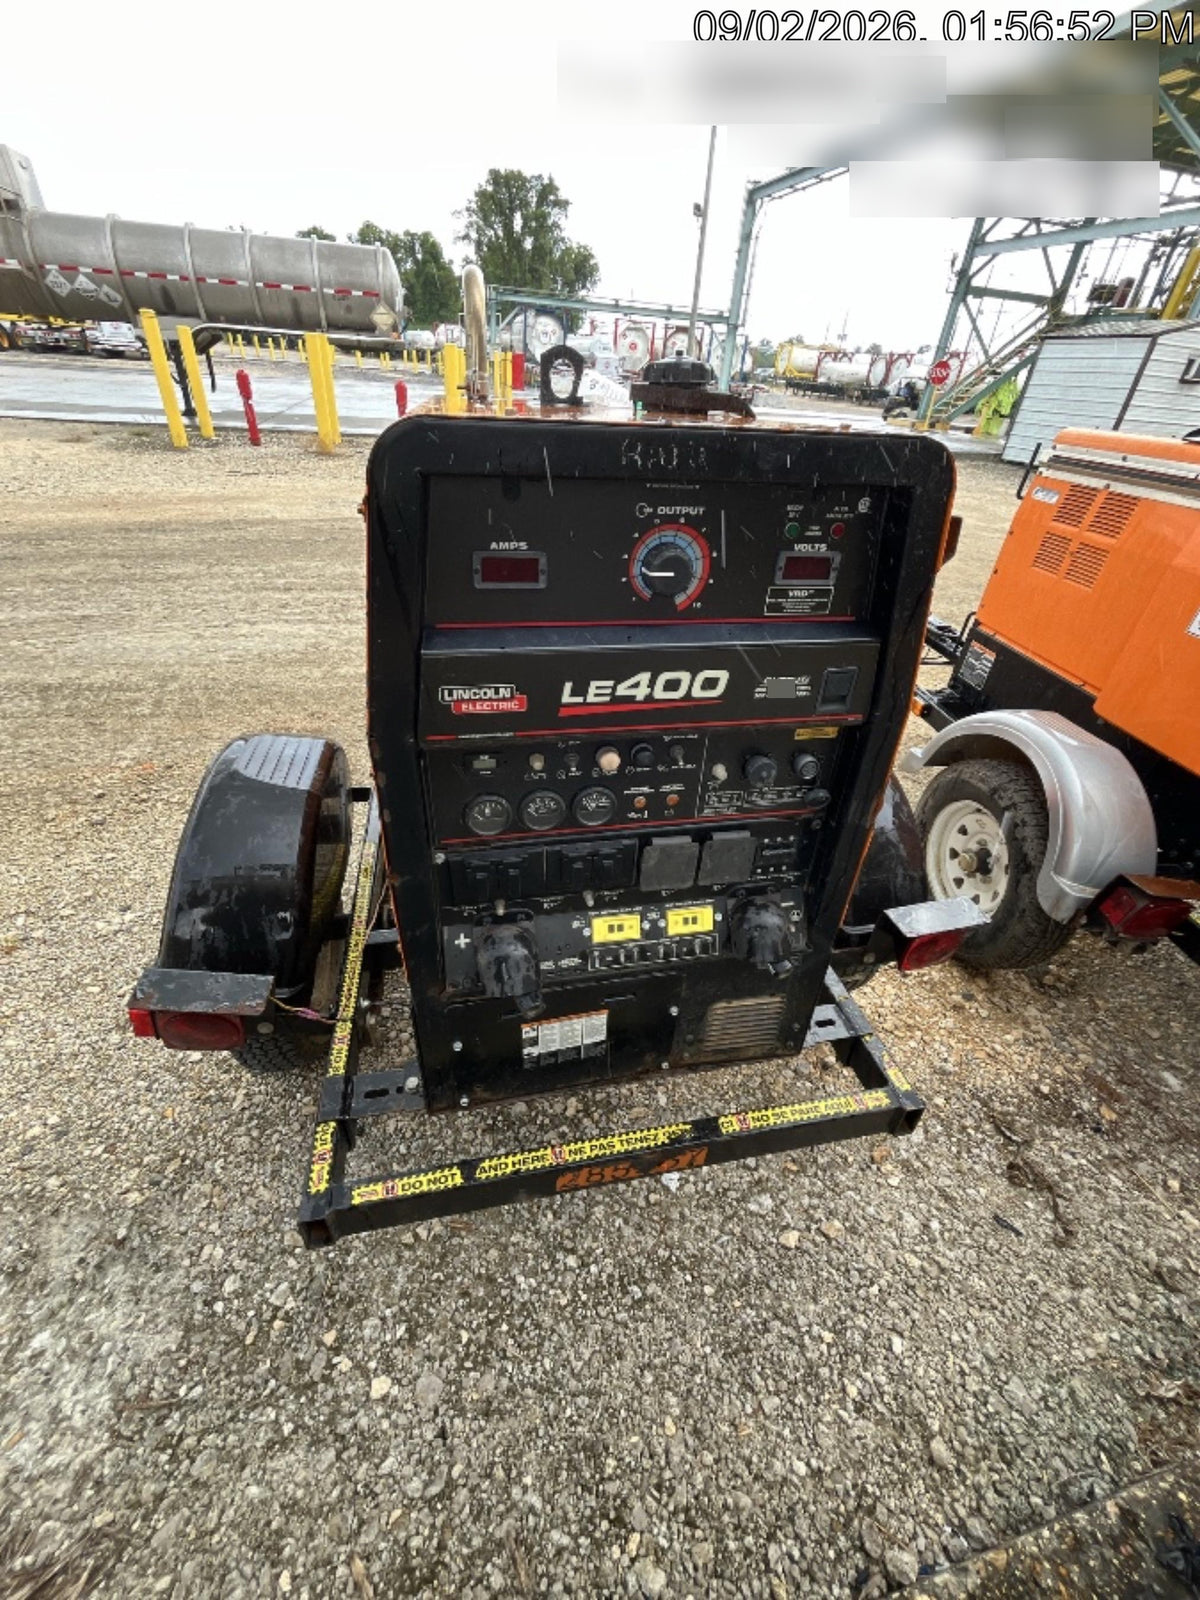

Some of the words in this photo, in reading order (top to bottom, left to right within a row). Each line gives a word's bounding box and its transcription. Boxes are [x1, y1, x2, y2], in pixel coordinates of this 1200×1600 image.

[657, 506, 706, 516] OUTPUT
[489, 541, 529, 551] AMPS
[793, 543, 828, 553] VOLTS
[560, 669, 730, 704] LE400
[443, 687, 511, 702] LINCOLN
[461, 701, 520, 712] ELECTRIC
[751, 1114, 771, 1123] NO
[568, 1146, 588, 1157] NE
[590, 1140, 616, 1153] PAS
[619, 1133, 660, 1148] TENEZ
[479, 1161, 509, 1175] AND
[511, 1153, 550, 1169] HERE
[401, 1180, 424, 1193] DO
[427, 1172, 458, 1188] NOT
